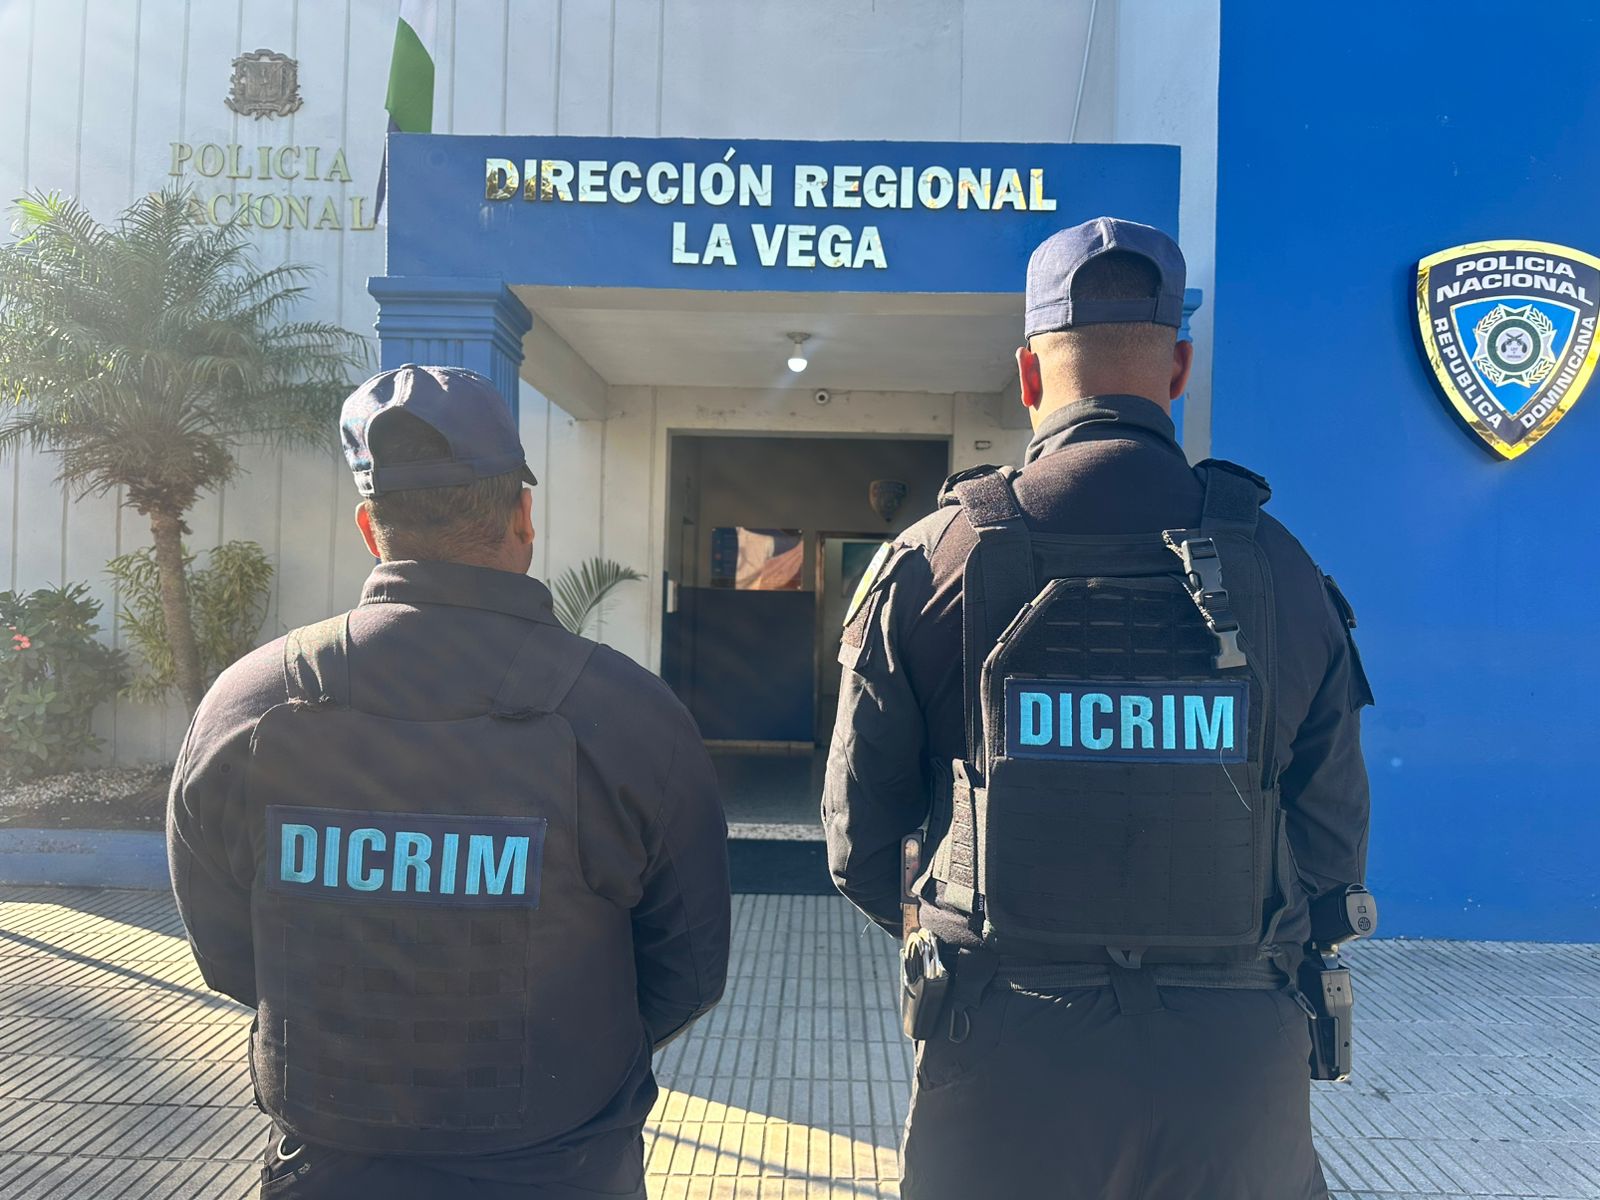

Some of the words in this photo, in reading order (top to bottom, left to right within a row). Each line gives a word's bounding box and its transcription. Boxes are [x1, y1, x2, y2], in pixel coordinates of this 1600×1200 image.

[168, 143, 352, 182] POLICIA
[485, 147, 773, 207] DIRECCIÓN
[794, 164, 1057, 211] REGIONAL
[672, 222, 738, 266] LA
[751, 223, 888, 269] VEGA
[1455, 255, 1576, 279] POLICIA
[1436, 273, 1594, 307] NACIONAL
[1433, 317, 1503, 429] REPUBLICA
[1520, 316, 1596, 429] DOMINICANA
[1019, 692, 1235, 750] DICRIM
[280, 823, 530, 895] DICRIM
